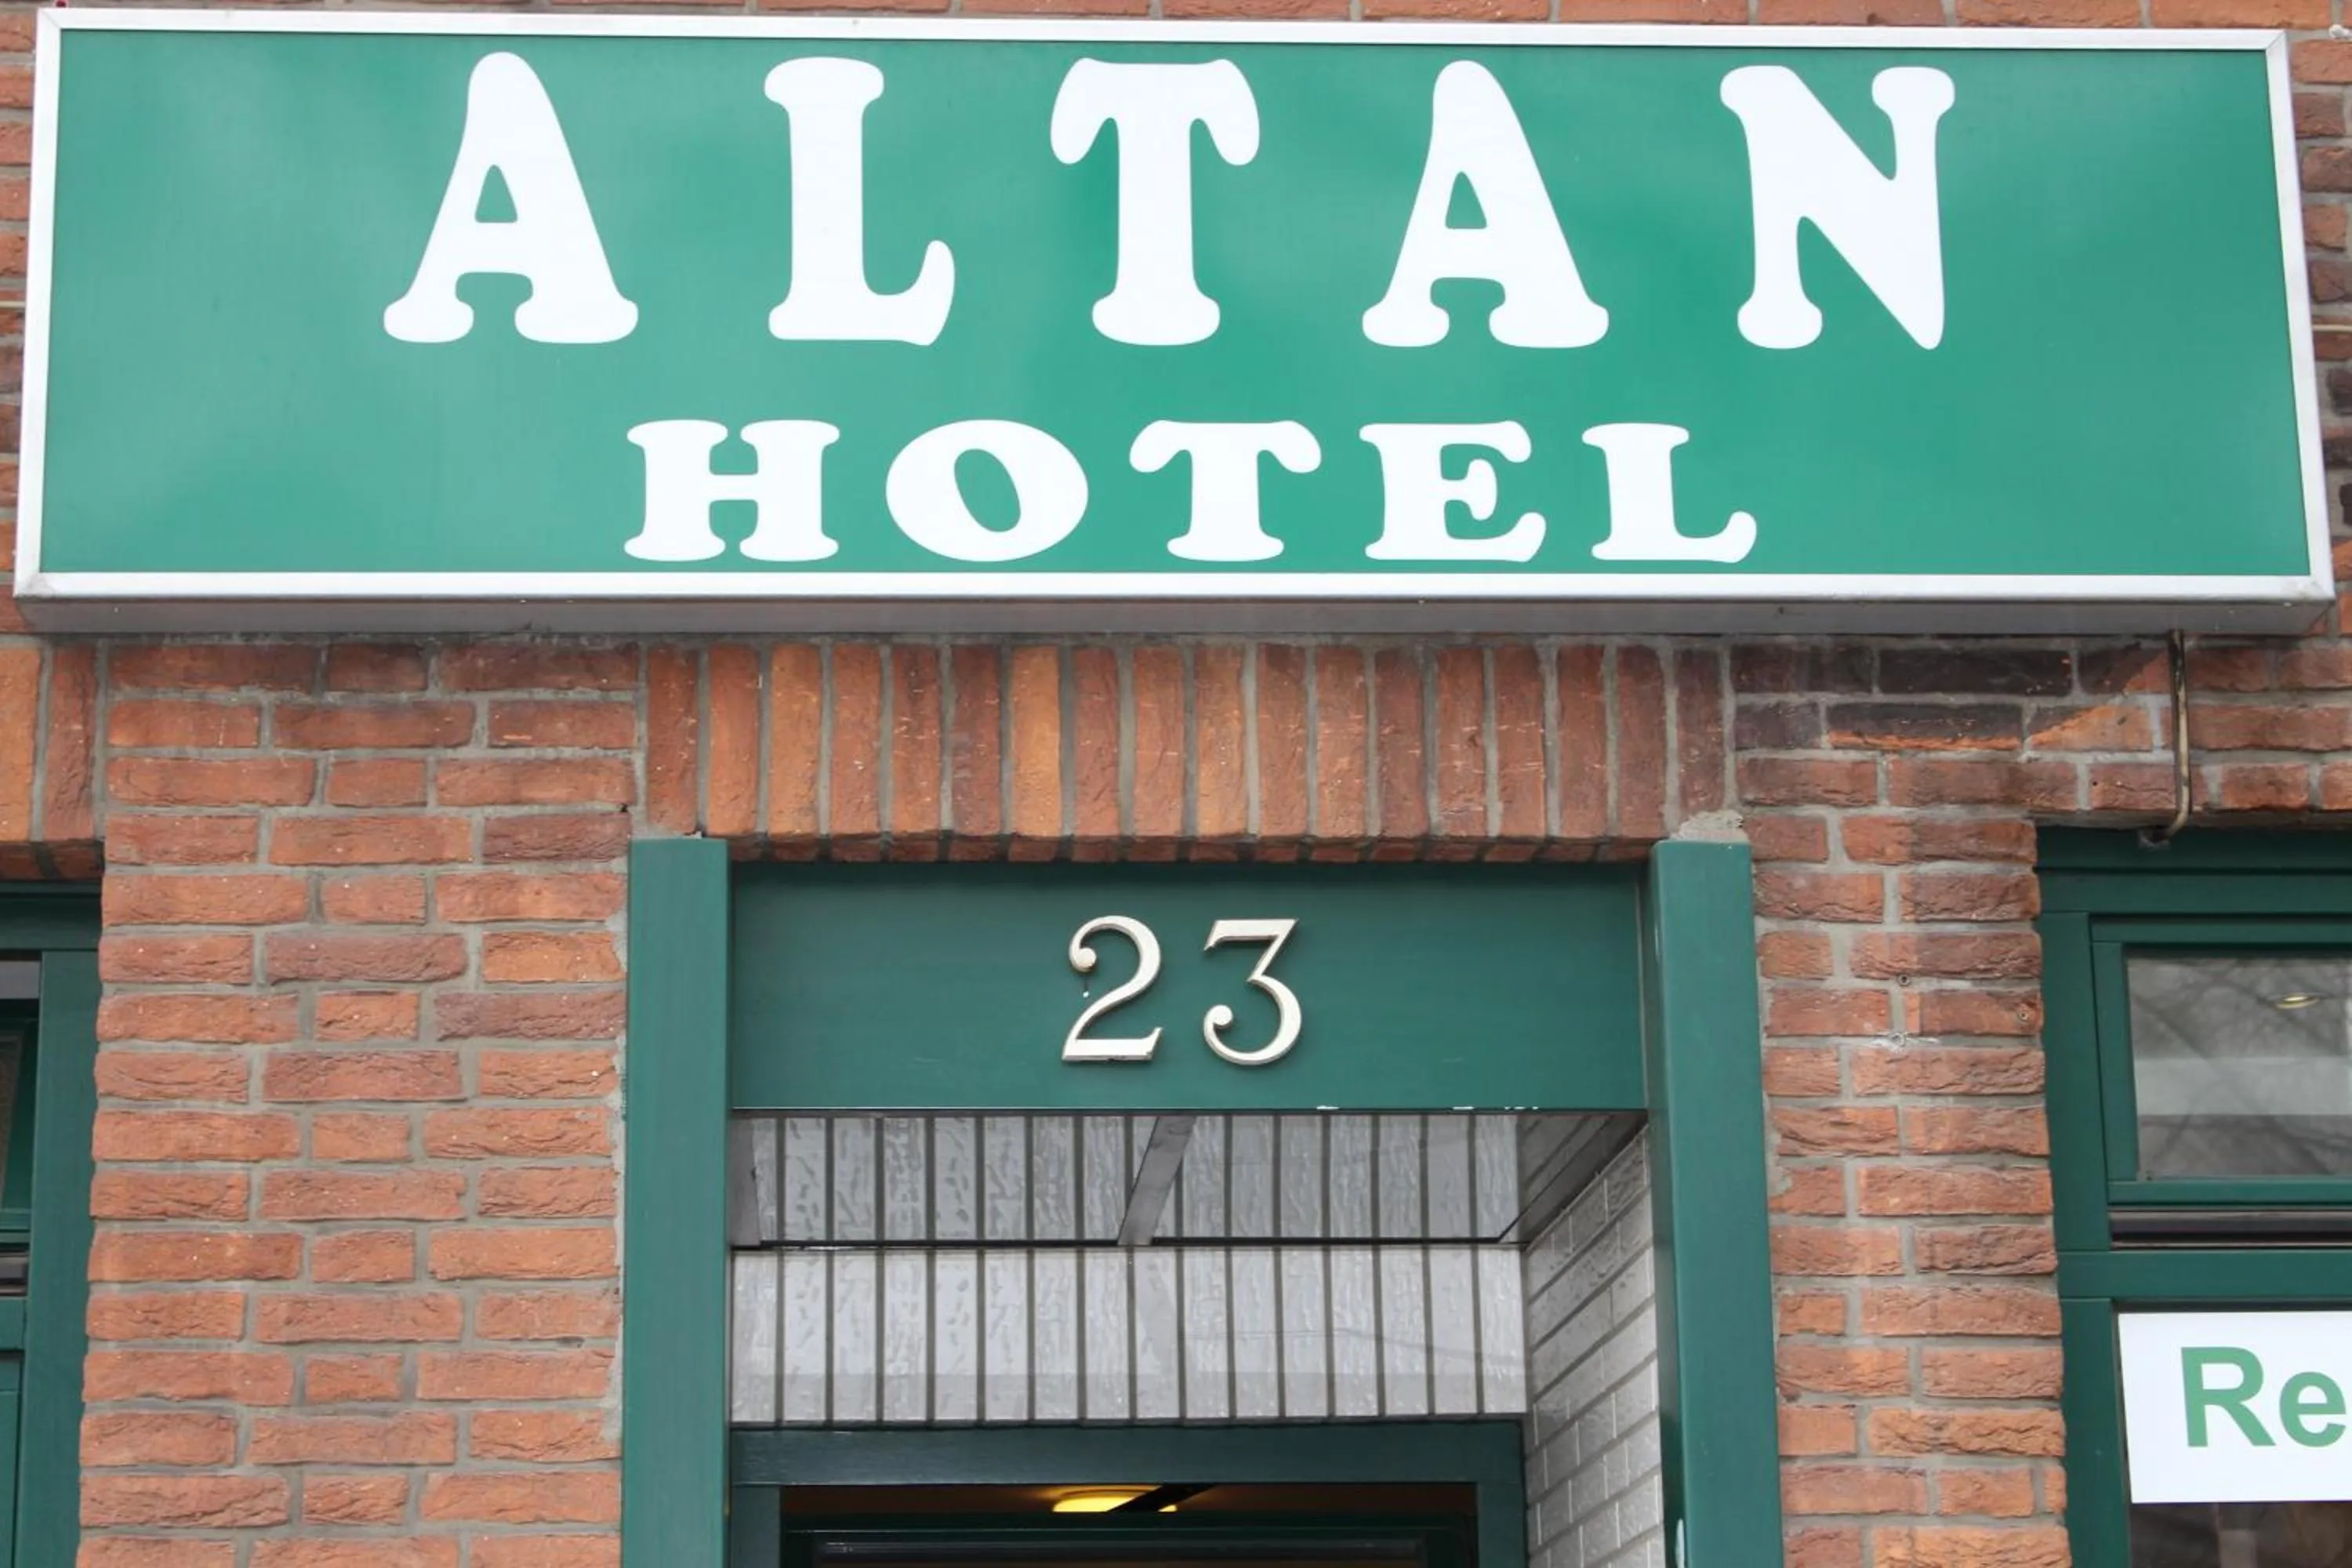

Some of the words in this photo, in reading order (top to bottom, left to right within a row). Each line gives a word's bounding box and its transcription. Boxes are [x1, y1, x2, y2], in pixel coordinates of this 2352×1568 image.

[383, 52, 1955, 350] ALTAN
[625, 419, 1758, 563] HOTEL
[1061, 914, 1302, 1065] 23
[2180, 1345, 2347, 1448] Re
